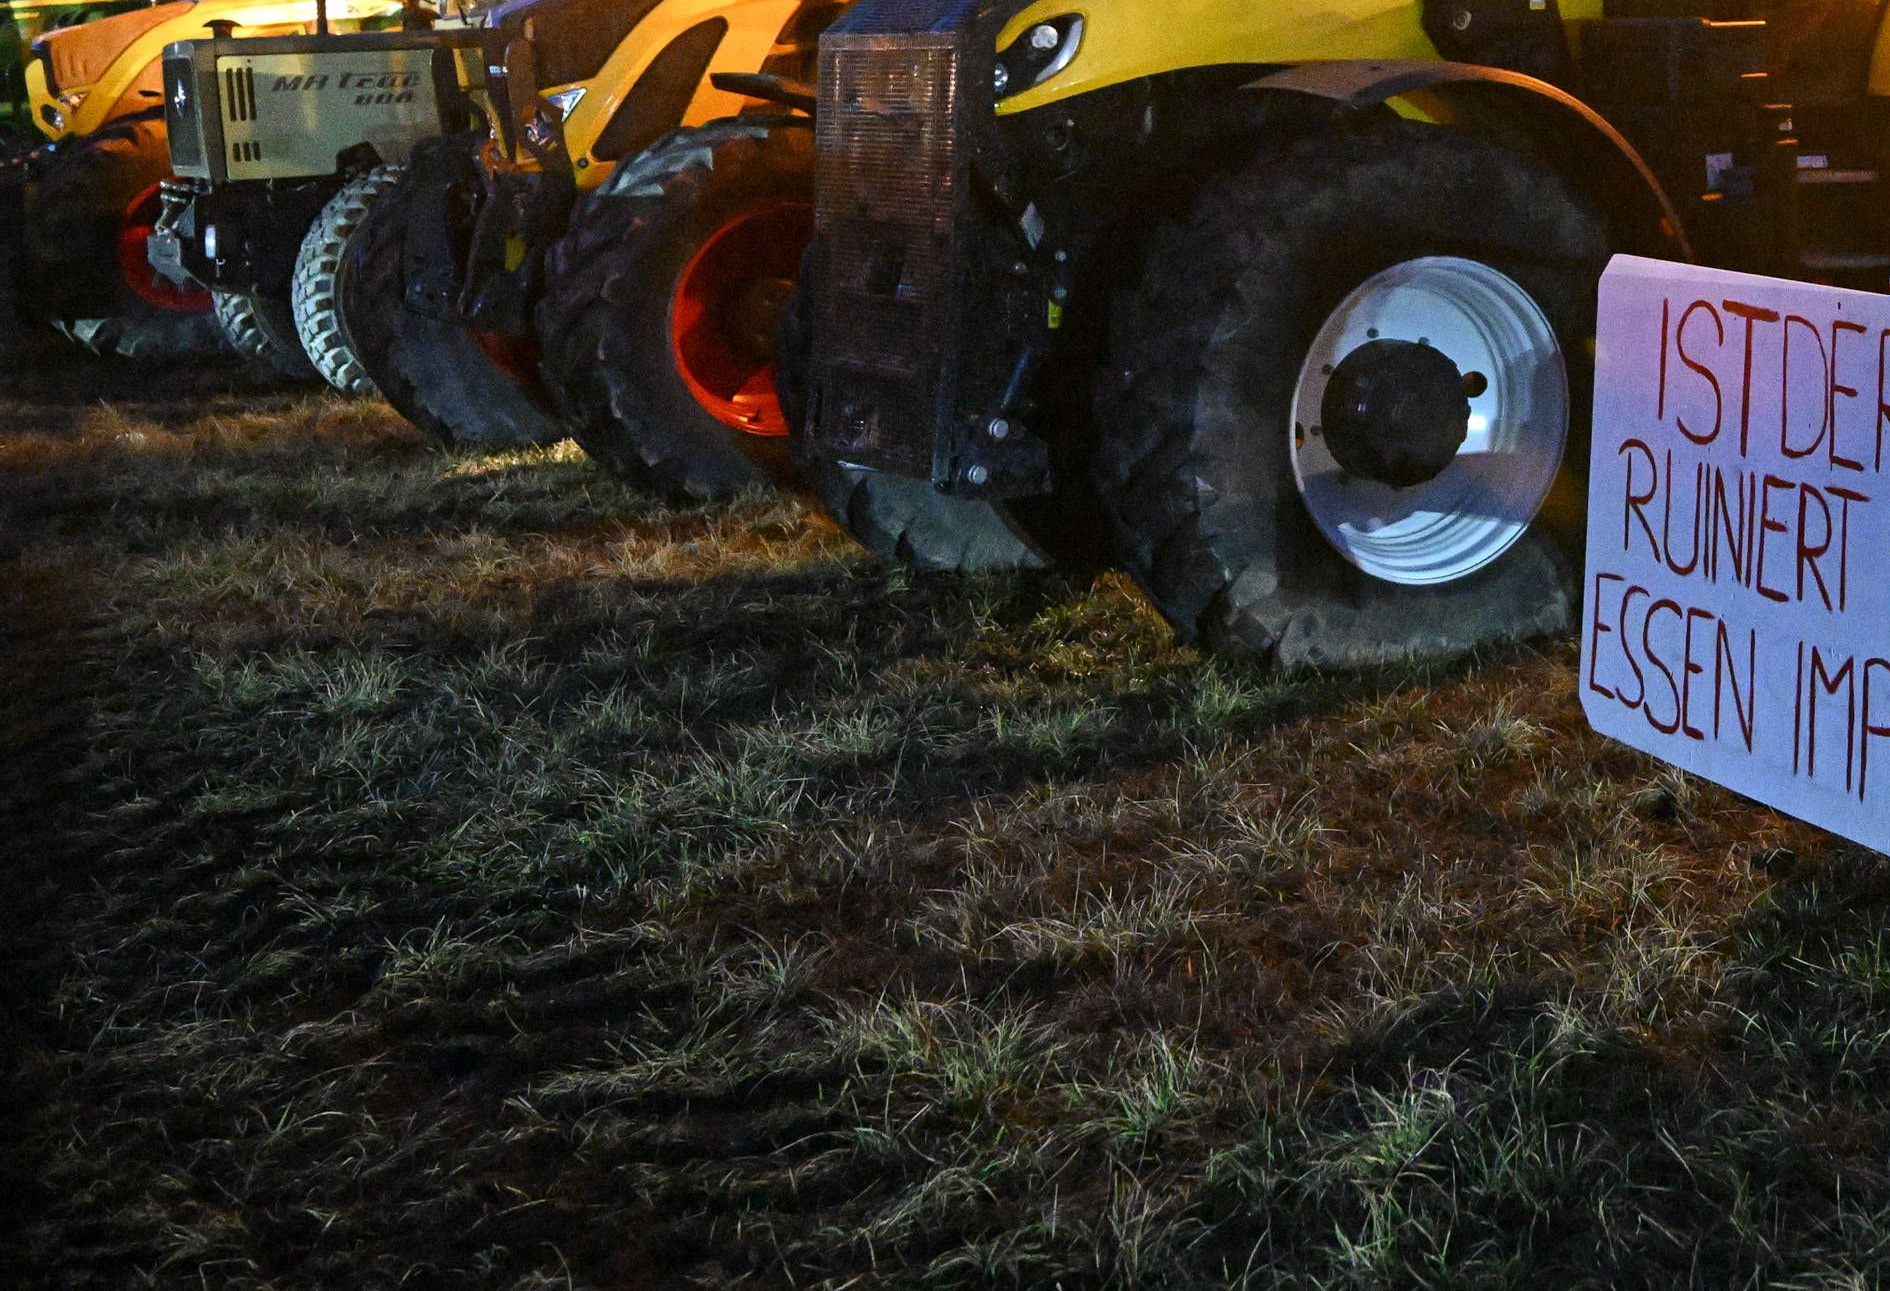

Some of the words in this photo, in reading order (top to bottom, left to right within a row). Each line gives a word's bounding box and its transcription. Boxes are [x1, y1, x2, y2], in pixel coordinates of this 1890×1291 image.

[1658, 298, 1780, 457] IST
[1619, 437, 1870, 613] RUINIERT
[1589, 572, 1756, 754] ESSEN
